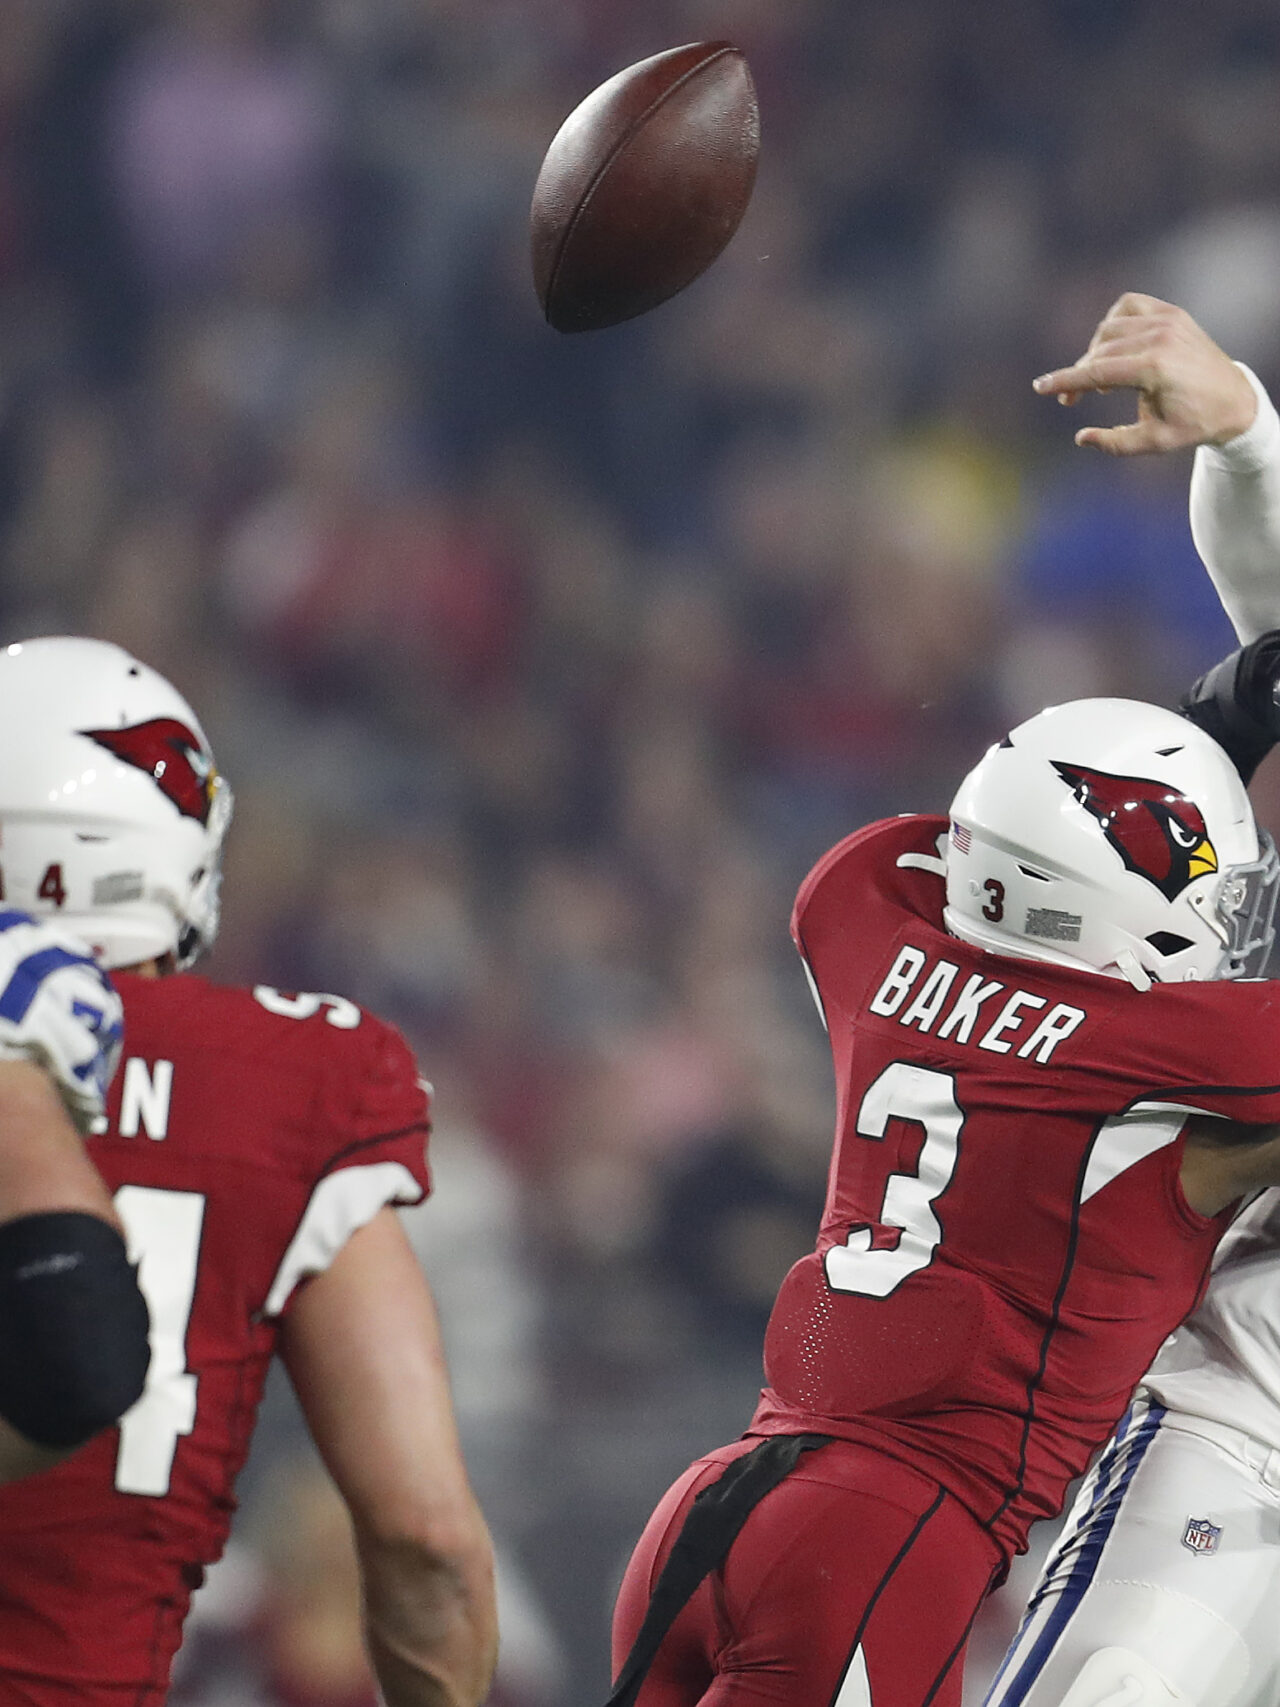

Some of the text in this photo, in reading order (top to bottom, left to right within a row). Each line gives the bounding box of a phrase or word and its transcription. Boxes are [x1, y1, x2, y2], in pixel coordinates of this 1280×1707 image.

[982, 878, 1005, 923] 3
[868, 943, 1087, 1065] BAKER
[91, 1056, 174, 1141] N
[824, 1059, 966, 1299] 3
[1187, 1529, 1214, 1550] NFL
